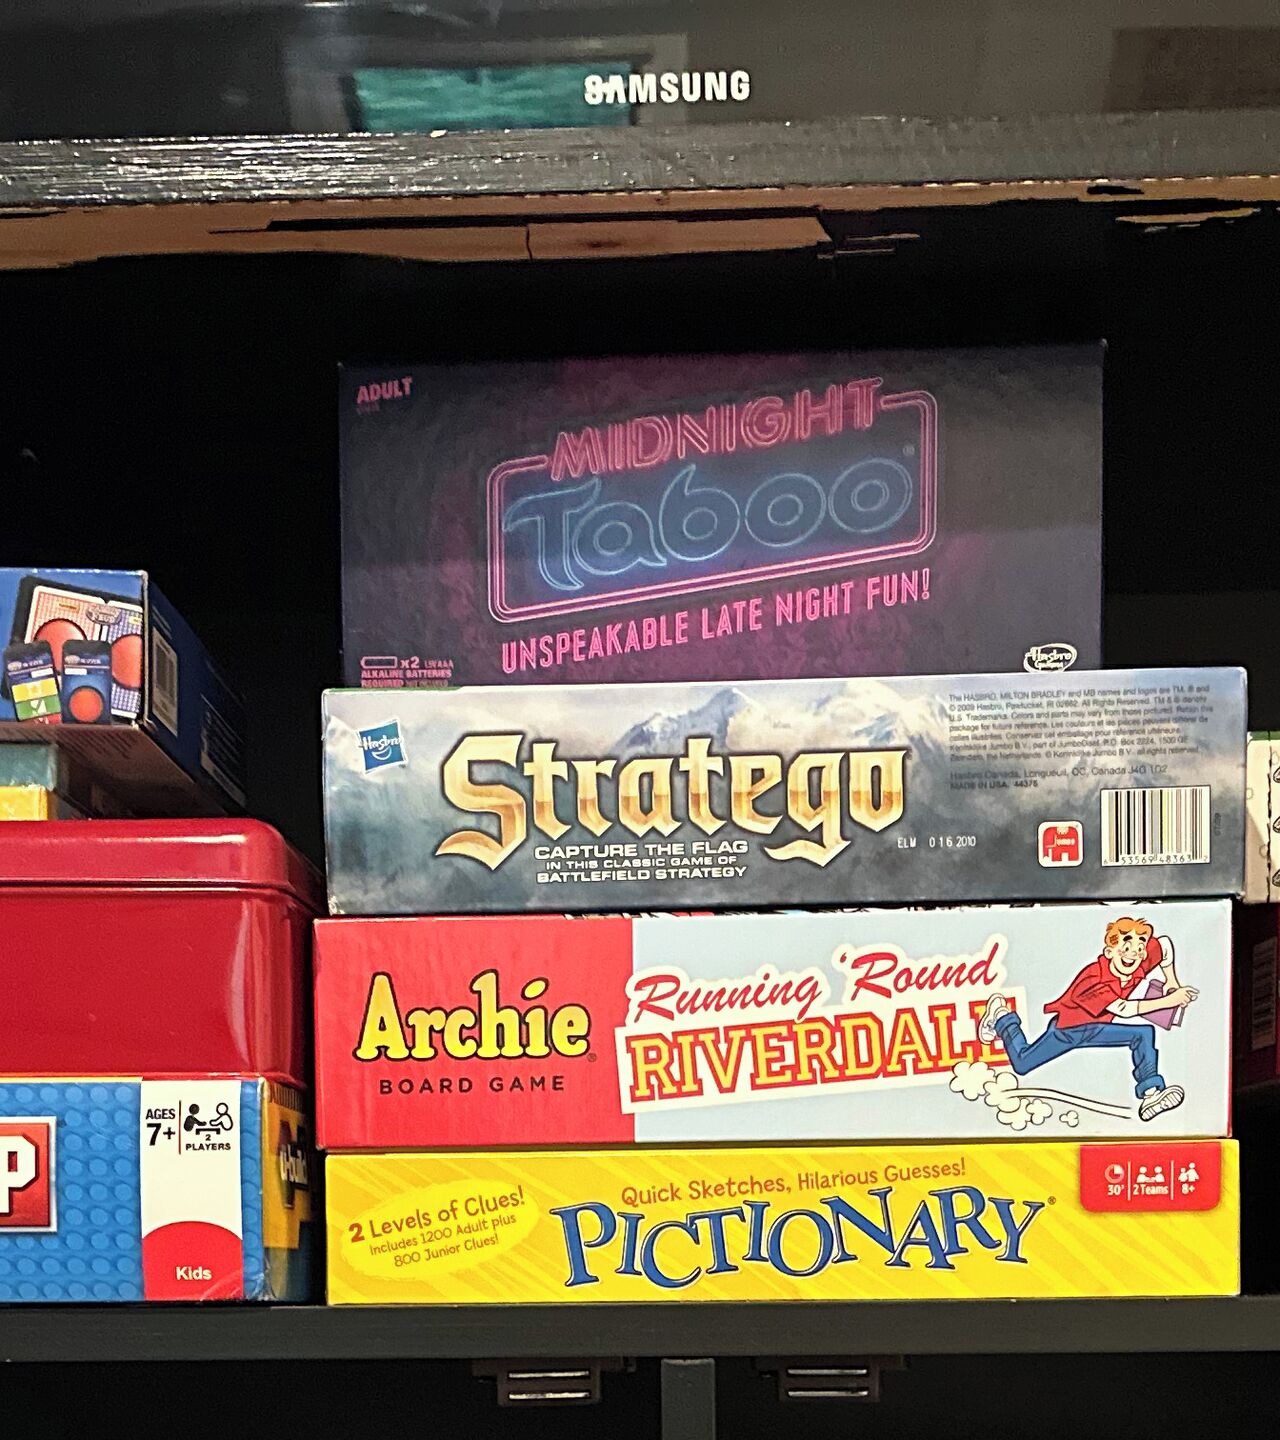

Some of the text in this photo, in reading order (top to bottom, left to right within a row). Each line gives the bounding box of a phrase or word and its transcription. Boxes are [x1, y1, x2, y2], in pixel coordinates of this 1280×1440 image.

[584, 70, 750, 104] SAMSUNG
[356, 377, 414, 405] ADULT
[549, 377, 885, 483] MIDNIGHT
[501, 459, 914, 592] Taboo
[501, 568, 931, 675] UNSPEAKABLE LATE NIGHT FUN!
[435, 731, 909, 870] Stratego
[534, 840, 749, 860] CAPTURE THE FLAG
[536, 866, 747, 884] BATTLEFIELD STRATEGY
[352, 968, 591, 1063] Archie
[632, 970, 822, 1024] Running
[147, 1123, 175, 1147] 7+
[621, 1157, 966, 1207] Quick Sketches, Hilarious Guesses!
[349, 1186, 526, 1242] 2 Levels of Clues!
[549, 1185, 1045, 1289] PICTIONARY
[176, 1265, 213, 1282] Kids
